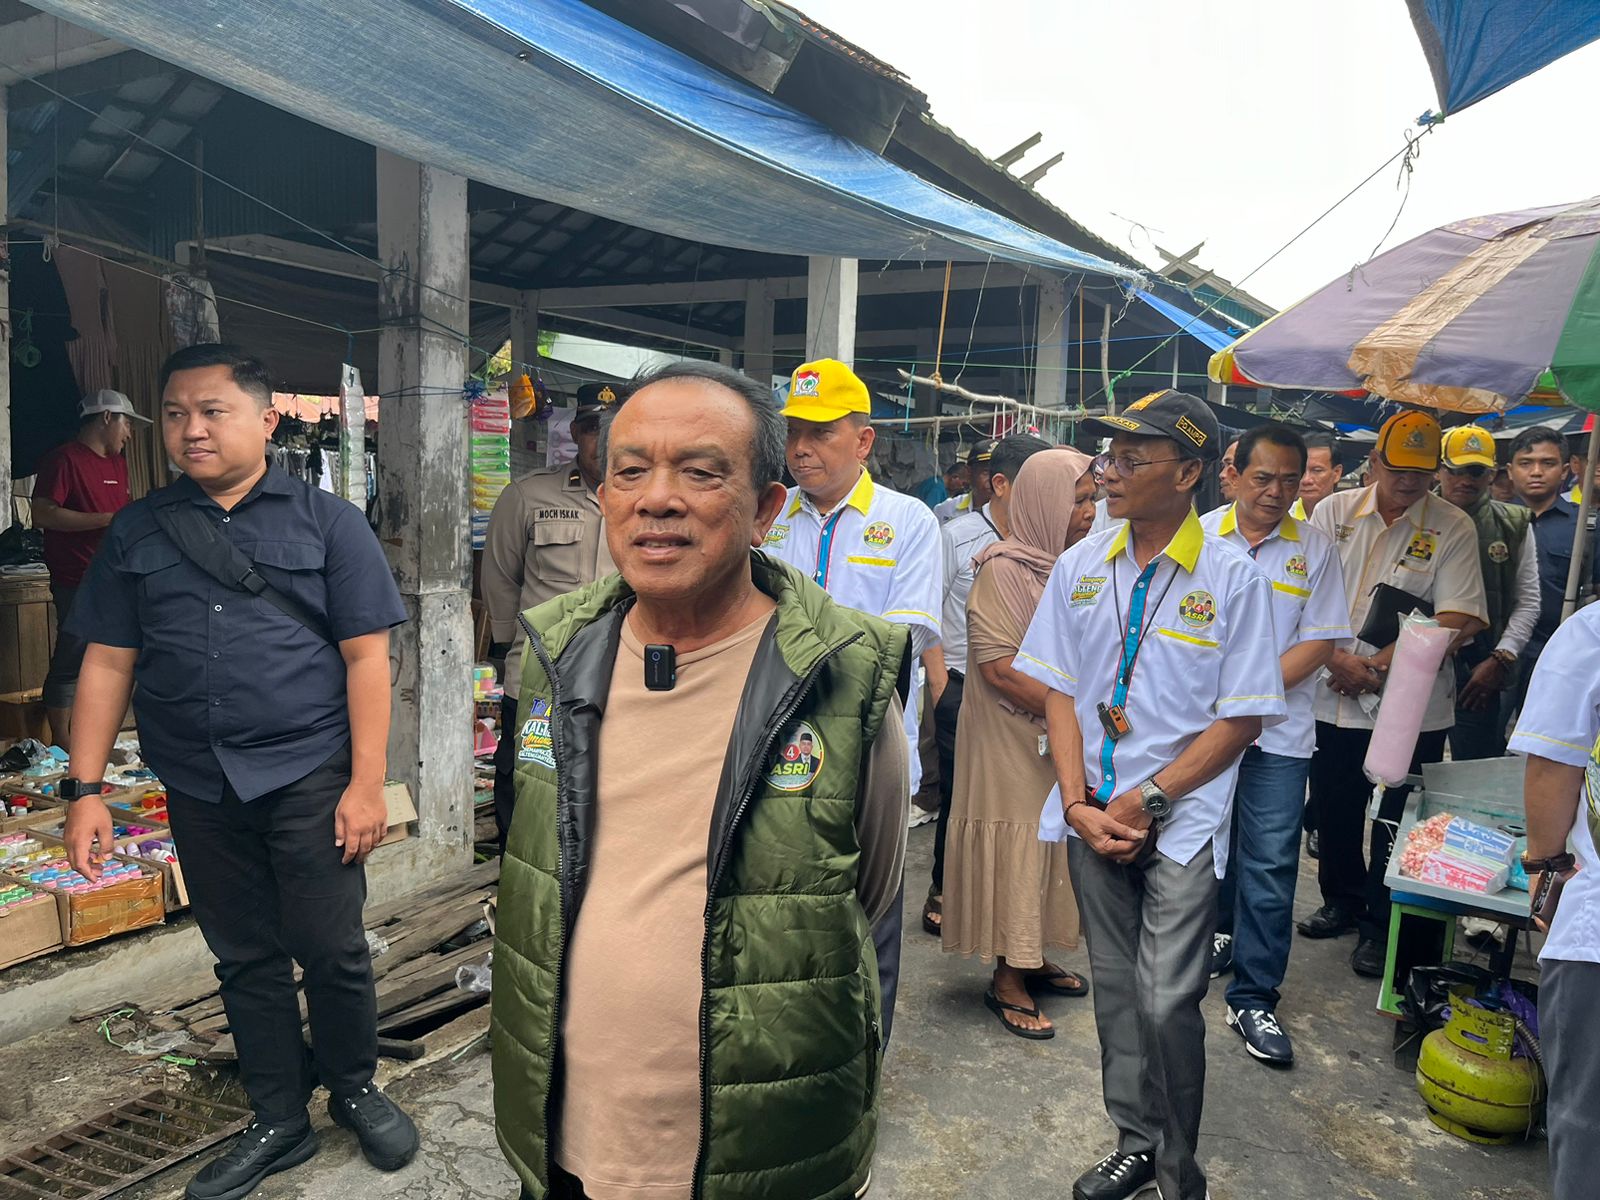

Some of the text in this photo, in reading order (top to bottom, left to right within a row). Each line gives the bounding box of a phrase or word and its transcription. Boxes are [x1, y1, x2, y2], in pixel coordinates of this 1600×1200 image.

[539, 509, 579, 519] MOCH ISKAK
[1185, 611, 1208, 622] ASRI
[786, 746, 796, 759] 4
[769, 762, 811, 776] ASRI
